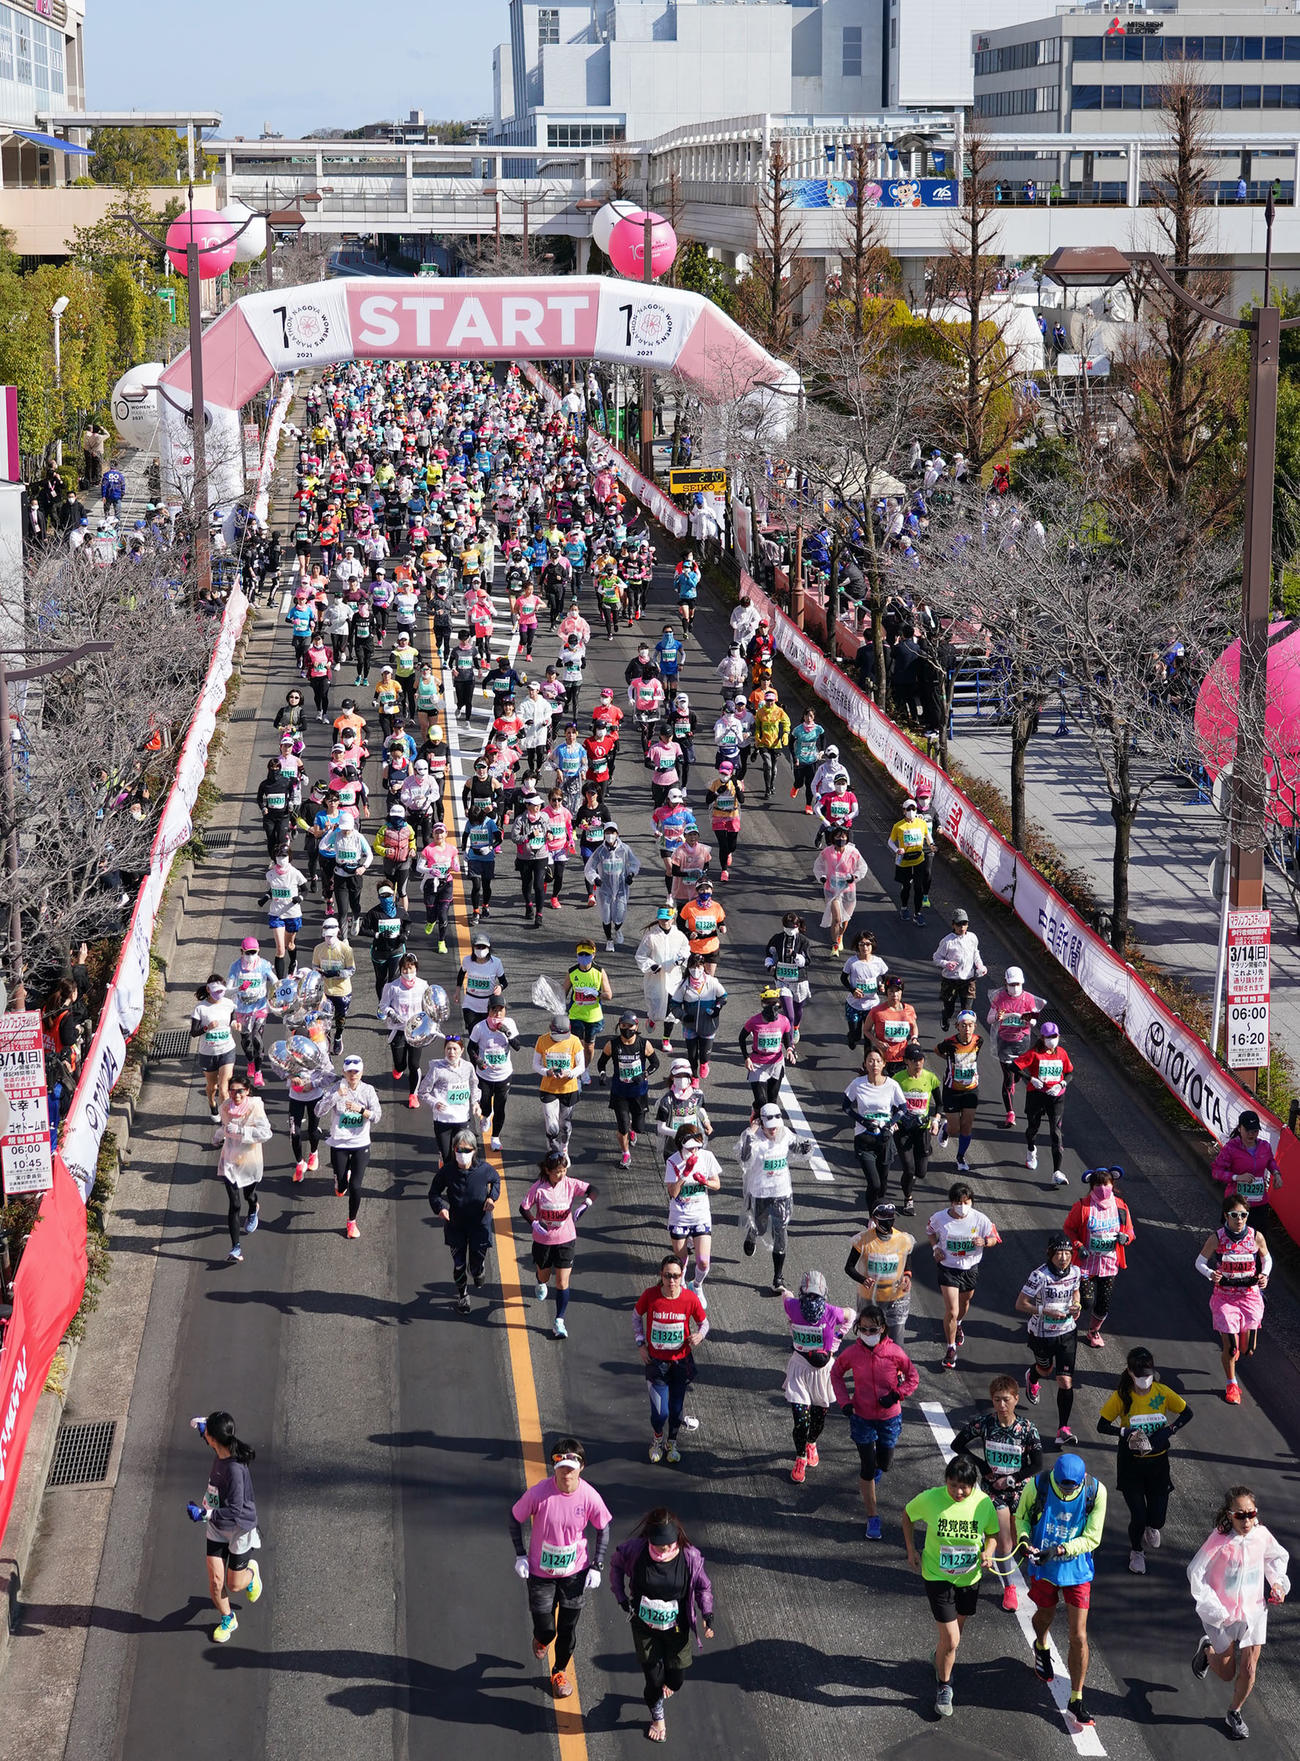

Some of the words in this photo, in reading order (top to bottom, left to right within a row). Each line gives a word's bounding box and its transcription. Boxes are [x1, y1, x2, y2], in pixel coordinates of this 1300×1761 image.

[359, 296, 589, 346] START
[1039, 908, 1082, 971] 中日新聞
[1232, 1007, 1266, 1020] 06:00
[1232, 1032, 1264, 1045] 16:20
[1165, 1041, 1224, 1133] TOYOTA
[449, 1092, 470, 1102] 4:00
[341, 1114, 363, 1126] 4:00
[11, 1144, 40, 1155] 06:00
[14, 1159, 42, 1169] 10:45
[652, 1329, 683, 1341] E13254
[986, 1450, 1020, 1467] E13075
[938, 1518, 979, 1533] 視覚障害
